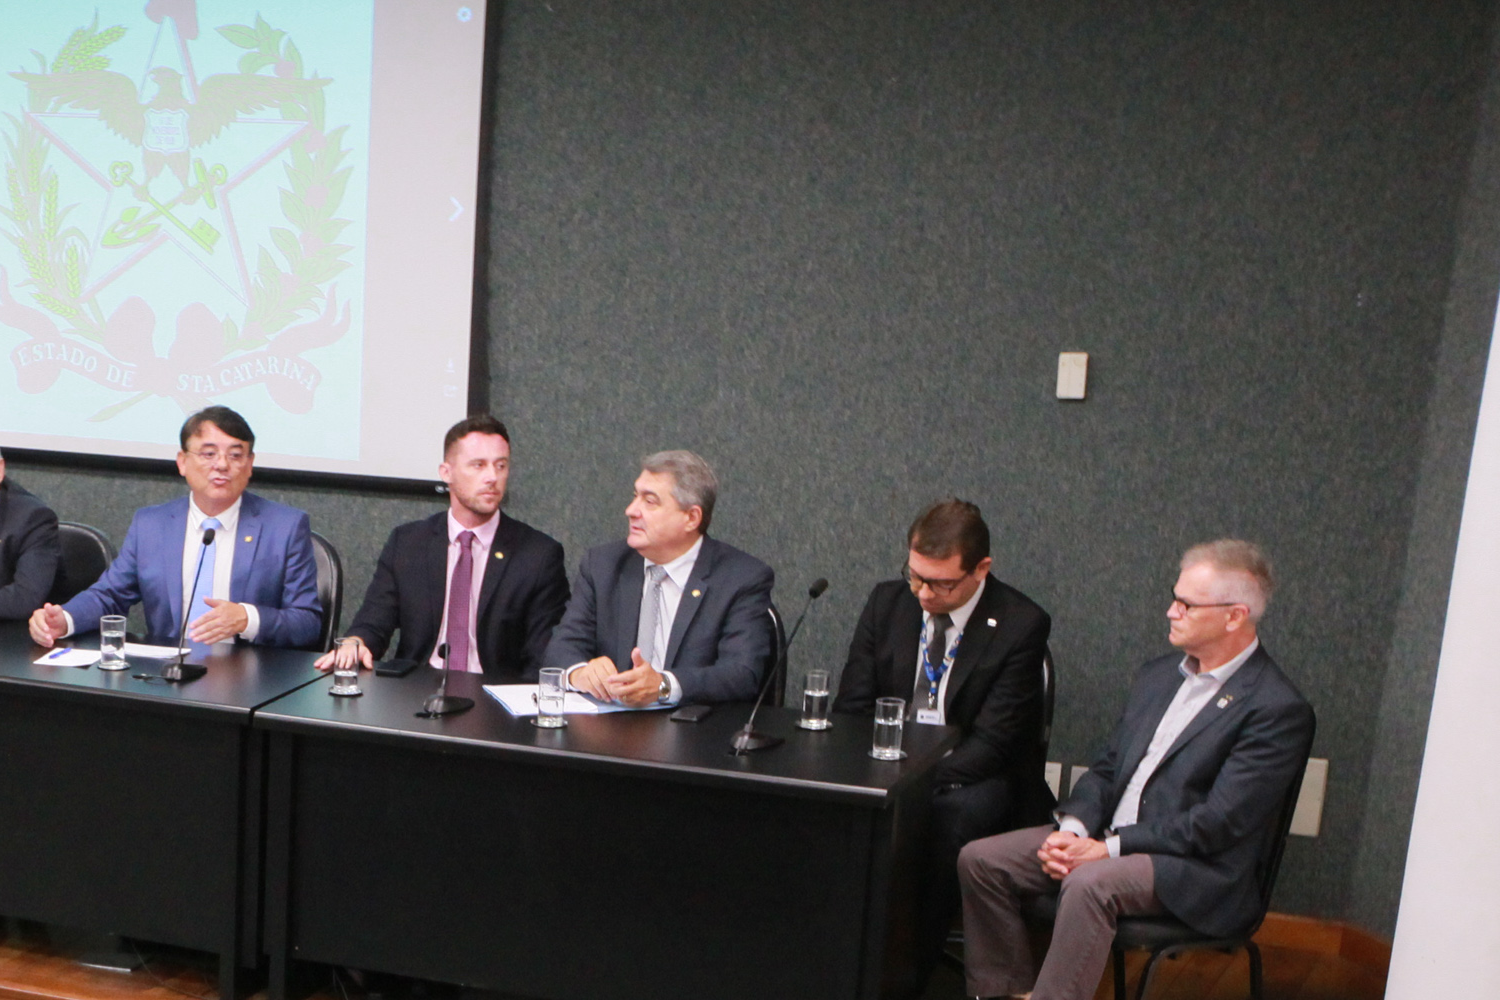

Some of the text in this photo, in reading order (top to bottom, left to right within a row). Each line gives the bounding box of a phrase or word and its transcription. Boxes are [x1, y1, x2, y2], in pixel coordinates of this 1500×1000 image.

[17, 342, 98, 373] ESTADO
[105, 364, 136, 387] DE
[219, 356, 316, 391] CATARINA
